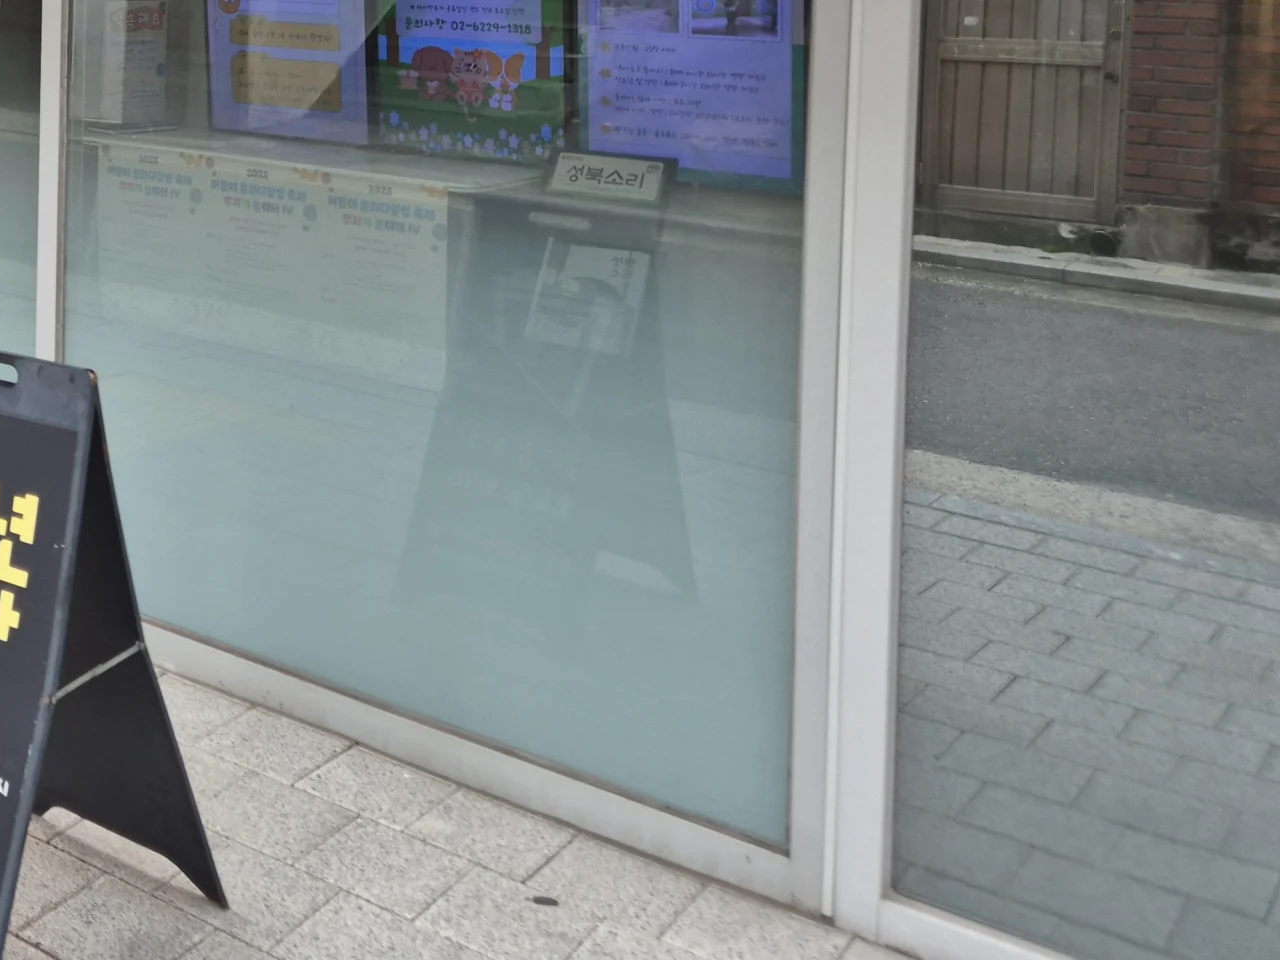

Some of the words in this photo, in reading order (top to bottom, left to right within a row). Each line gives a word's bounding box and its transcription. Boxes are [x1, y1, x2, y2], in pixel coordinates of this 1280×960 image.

[404, 16, 447, 31] 문의사항
[450, 20, 532, 35] 02-6229-1318
[566, 164, 646, 190] 성북소리
[367, 184, 393, 196] 2025
